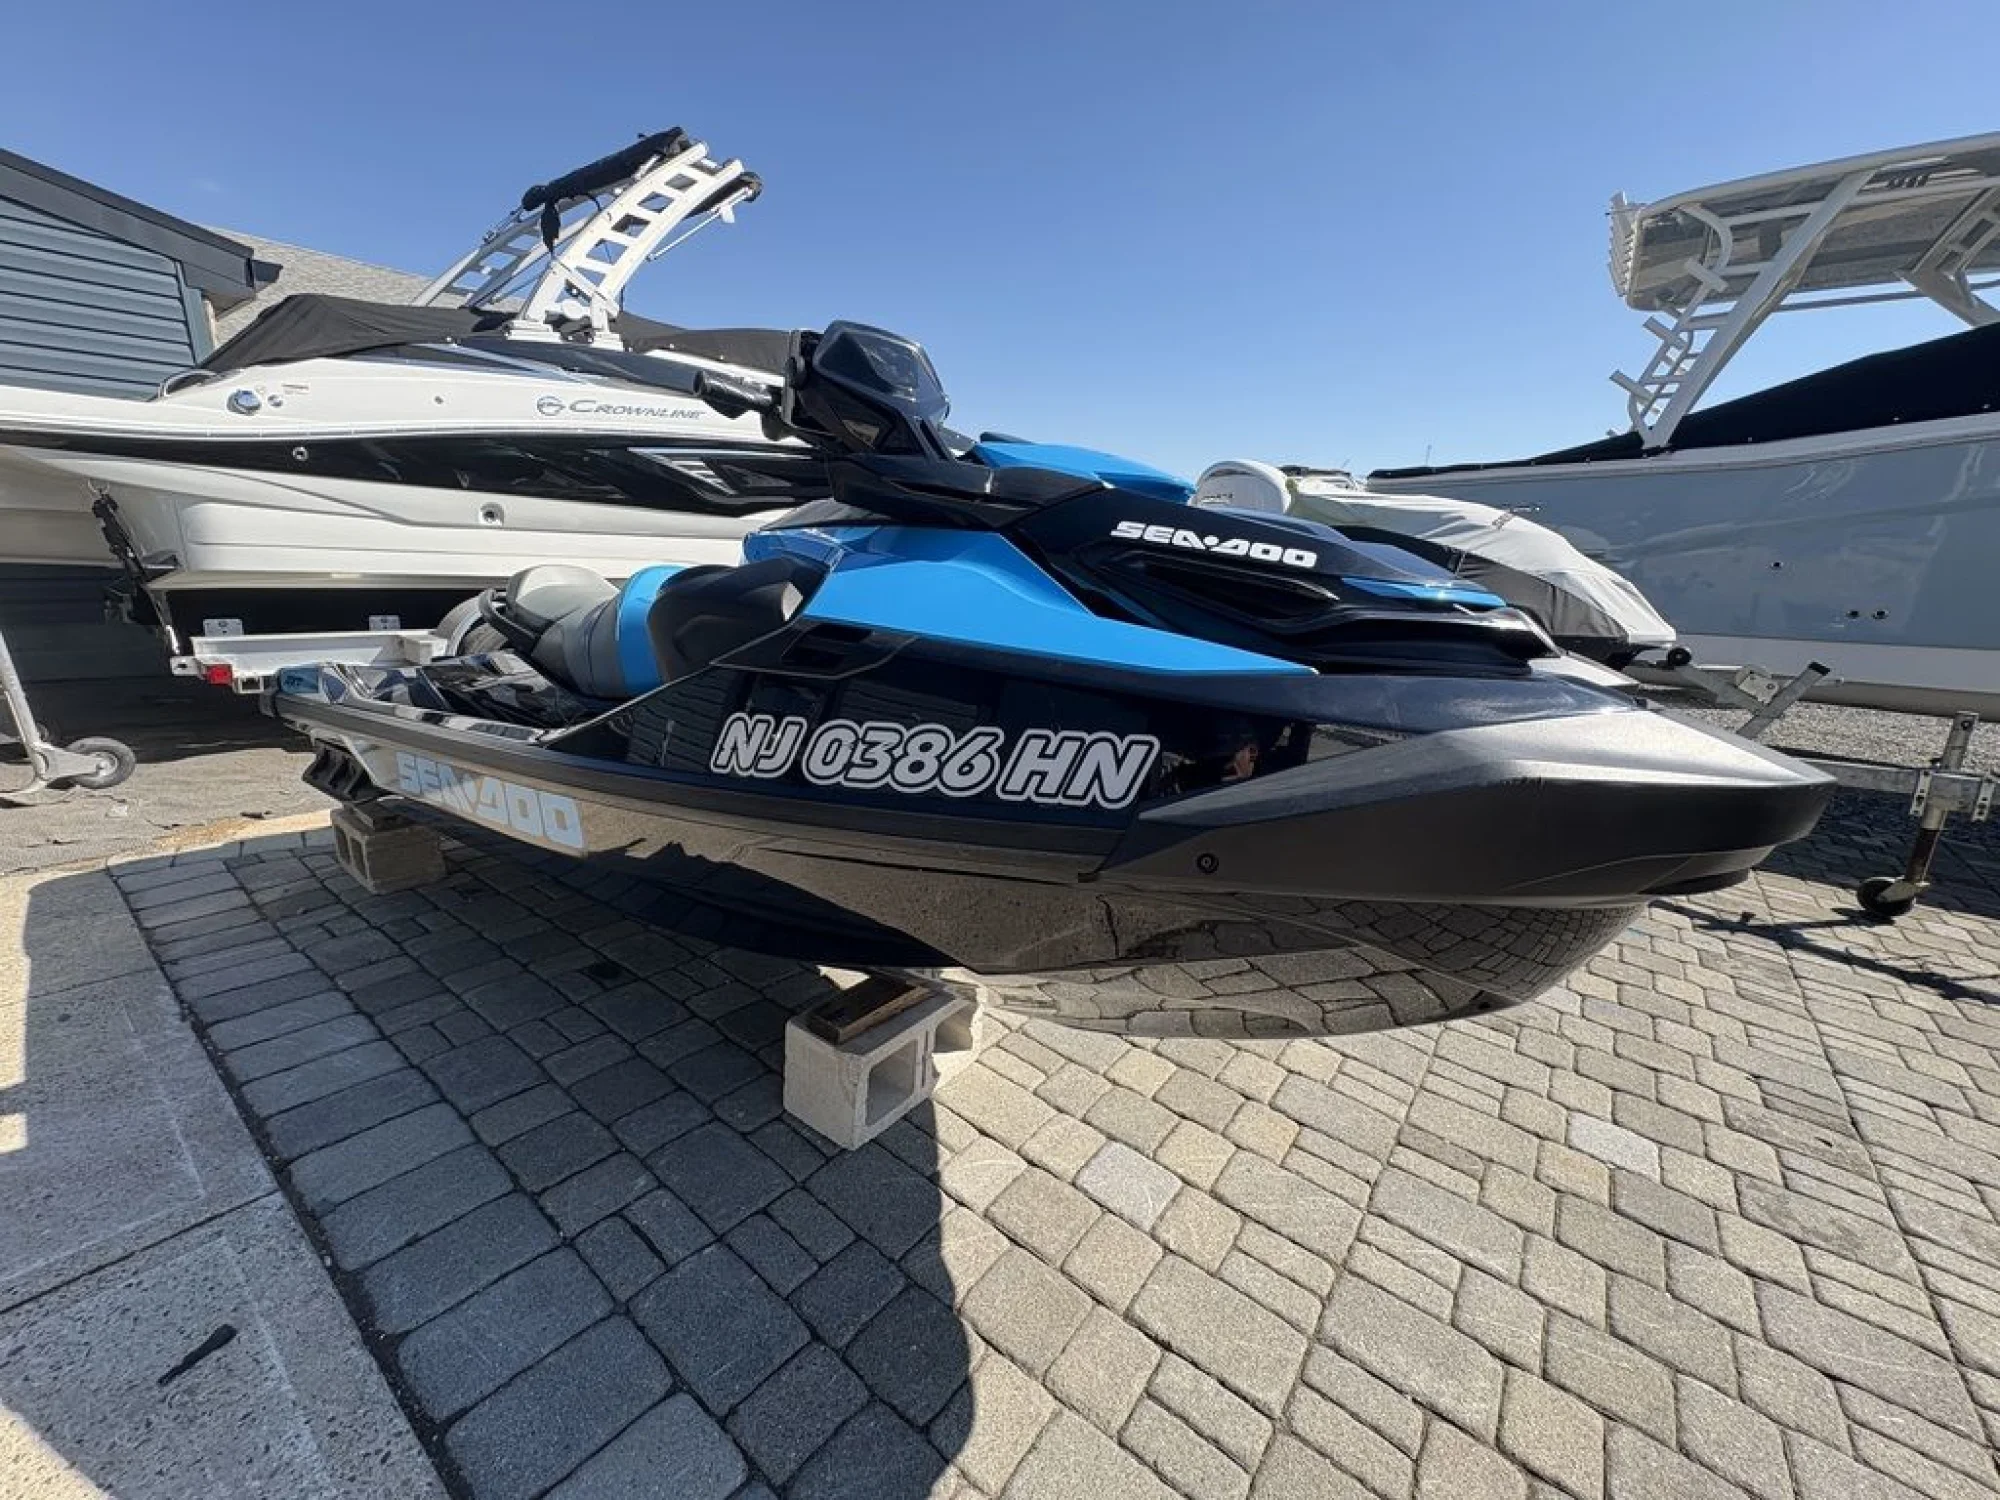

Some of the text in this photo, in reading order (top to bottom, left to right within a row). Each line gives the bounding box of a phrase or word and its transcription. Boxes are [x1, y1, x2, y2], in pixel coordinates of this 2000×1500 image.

[711, 712, 1161, 810] NJ 0386 HN
